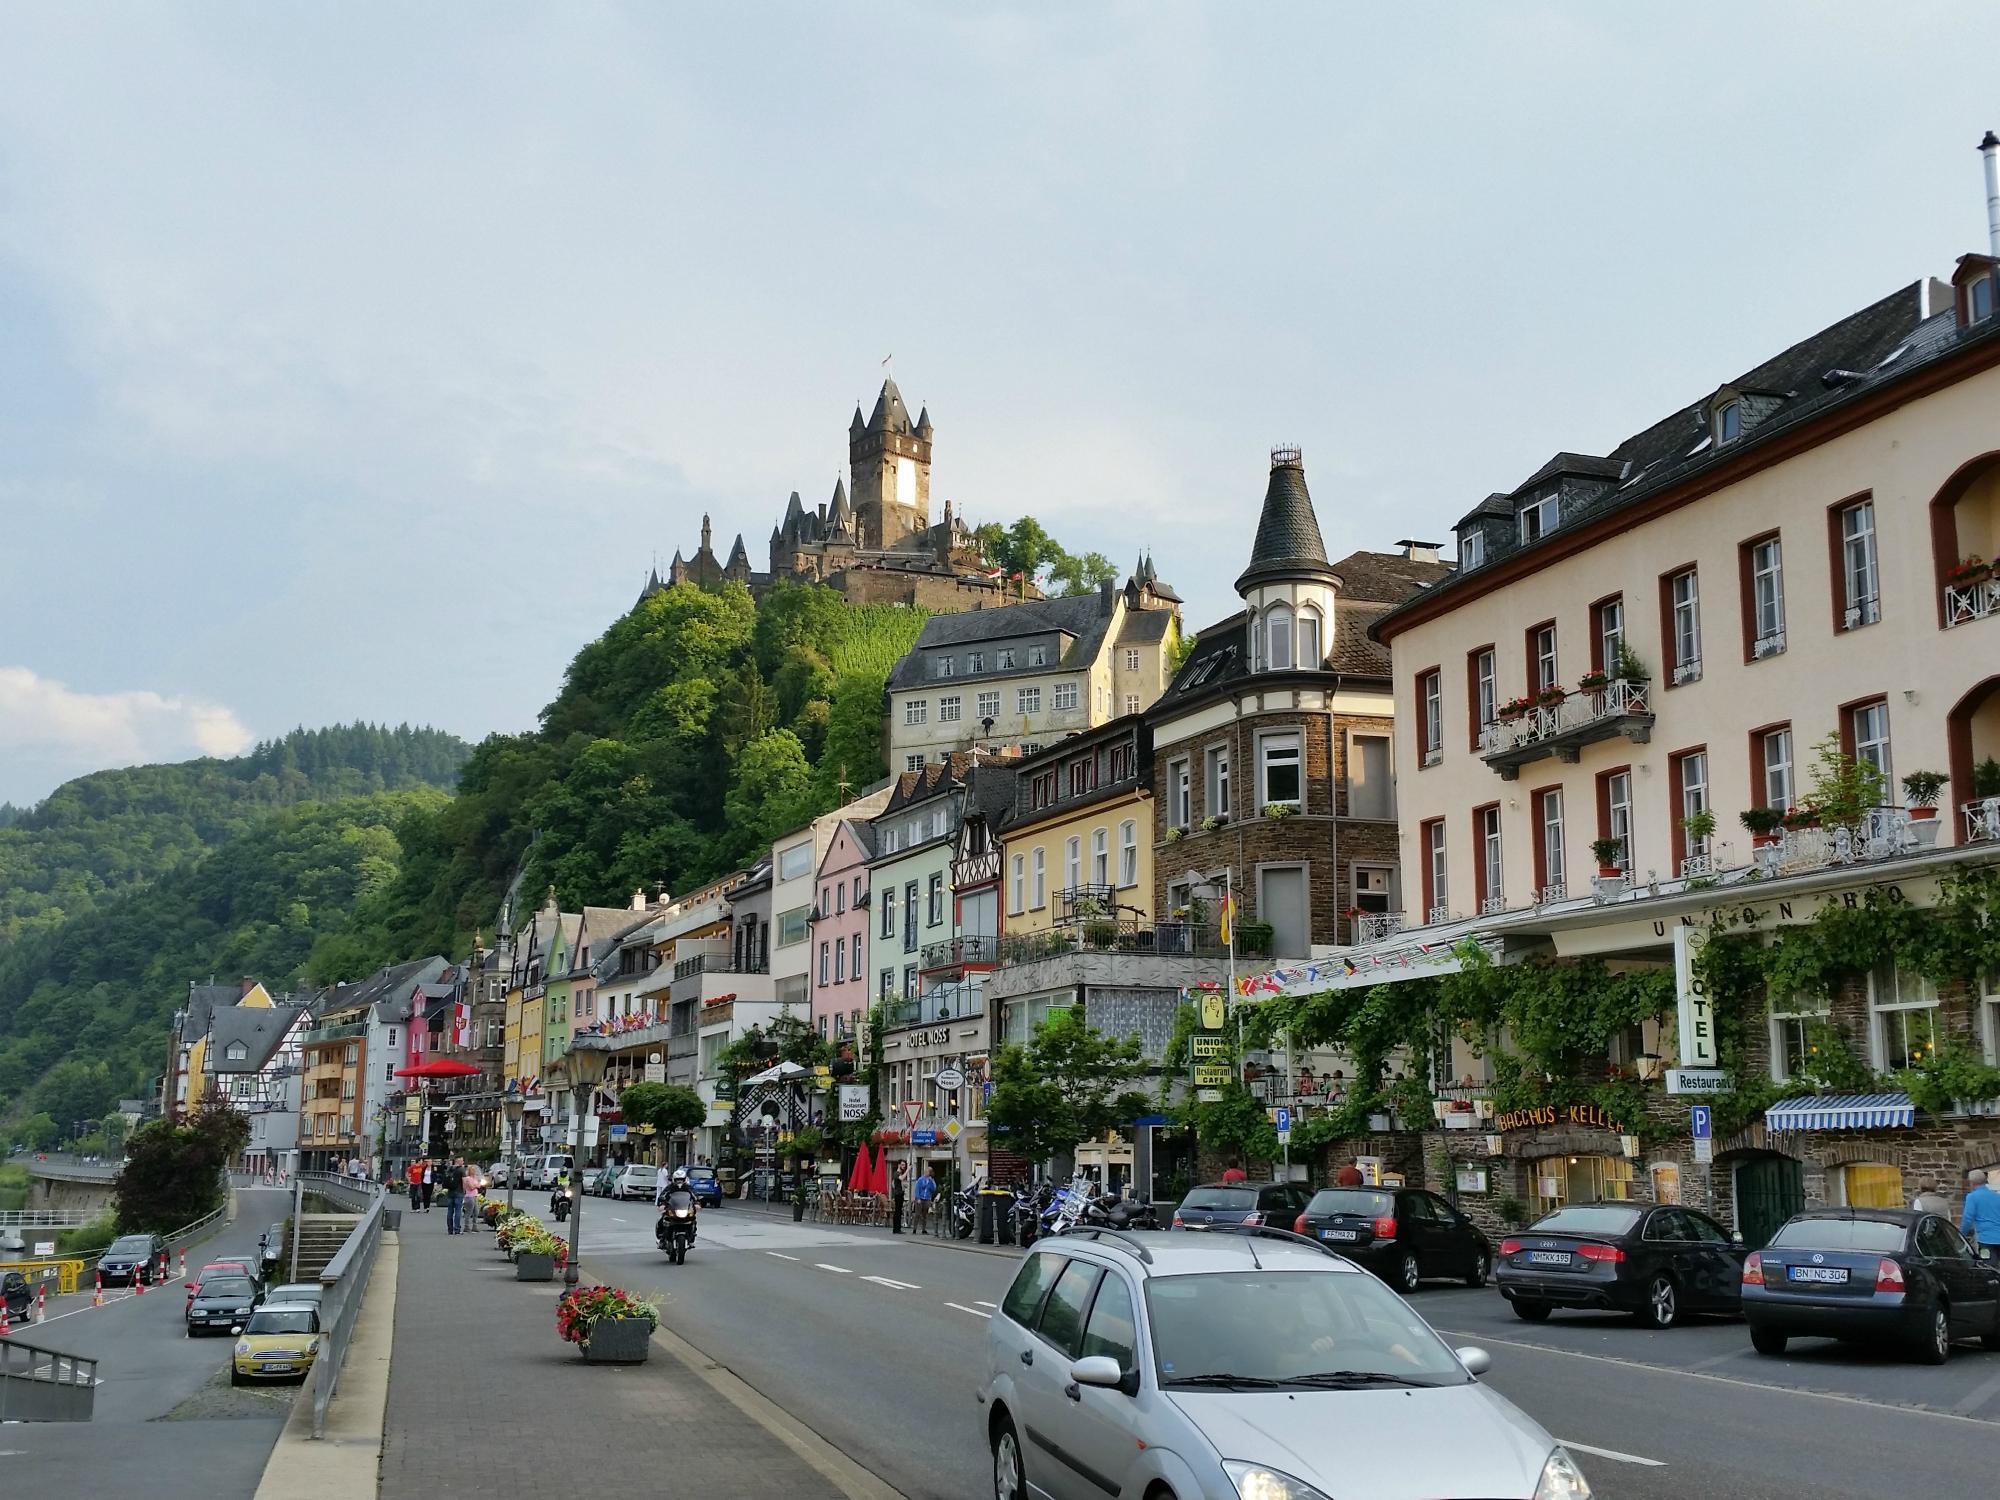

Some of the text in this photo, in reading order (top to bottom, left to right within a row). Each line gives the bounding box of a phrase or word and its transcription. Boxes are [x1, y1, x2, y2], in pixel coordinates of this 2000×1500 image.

[1653, 902, 1793, 937] UNION
[905, 1027, 947, 1047] HOTEL NOSS
[1196, 1067, 1230, 1076] Restaurant
[843, 1109, 866, 1118] NOSS
[1279, 1111, 1287, 1129] P
[1499, 1105, 1555, 1132] BACCHUS
[1695, 1110, 1707, 1134] P
[1796, 1269, 1847, 1280] BN NC 304
